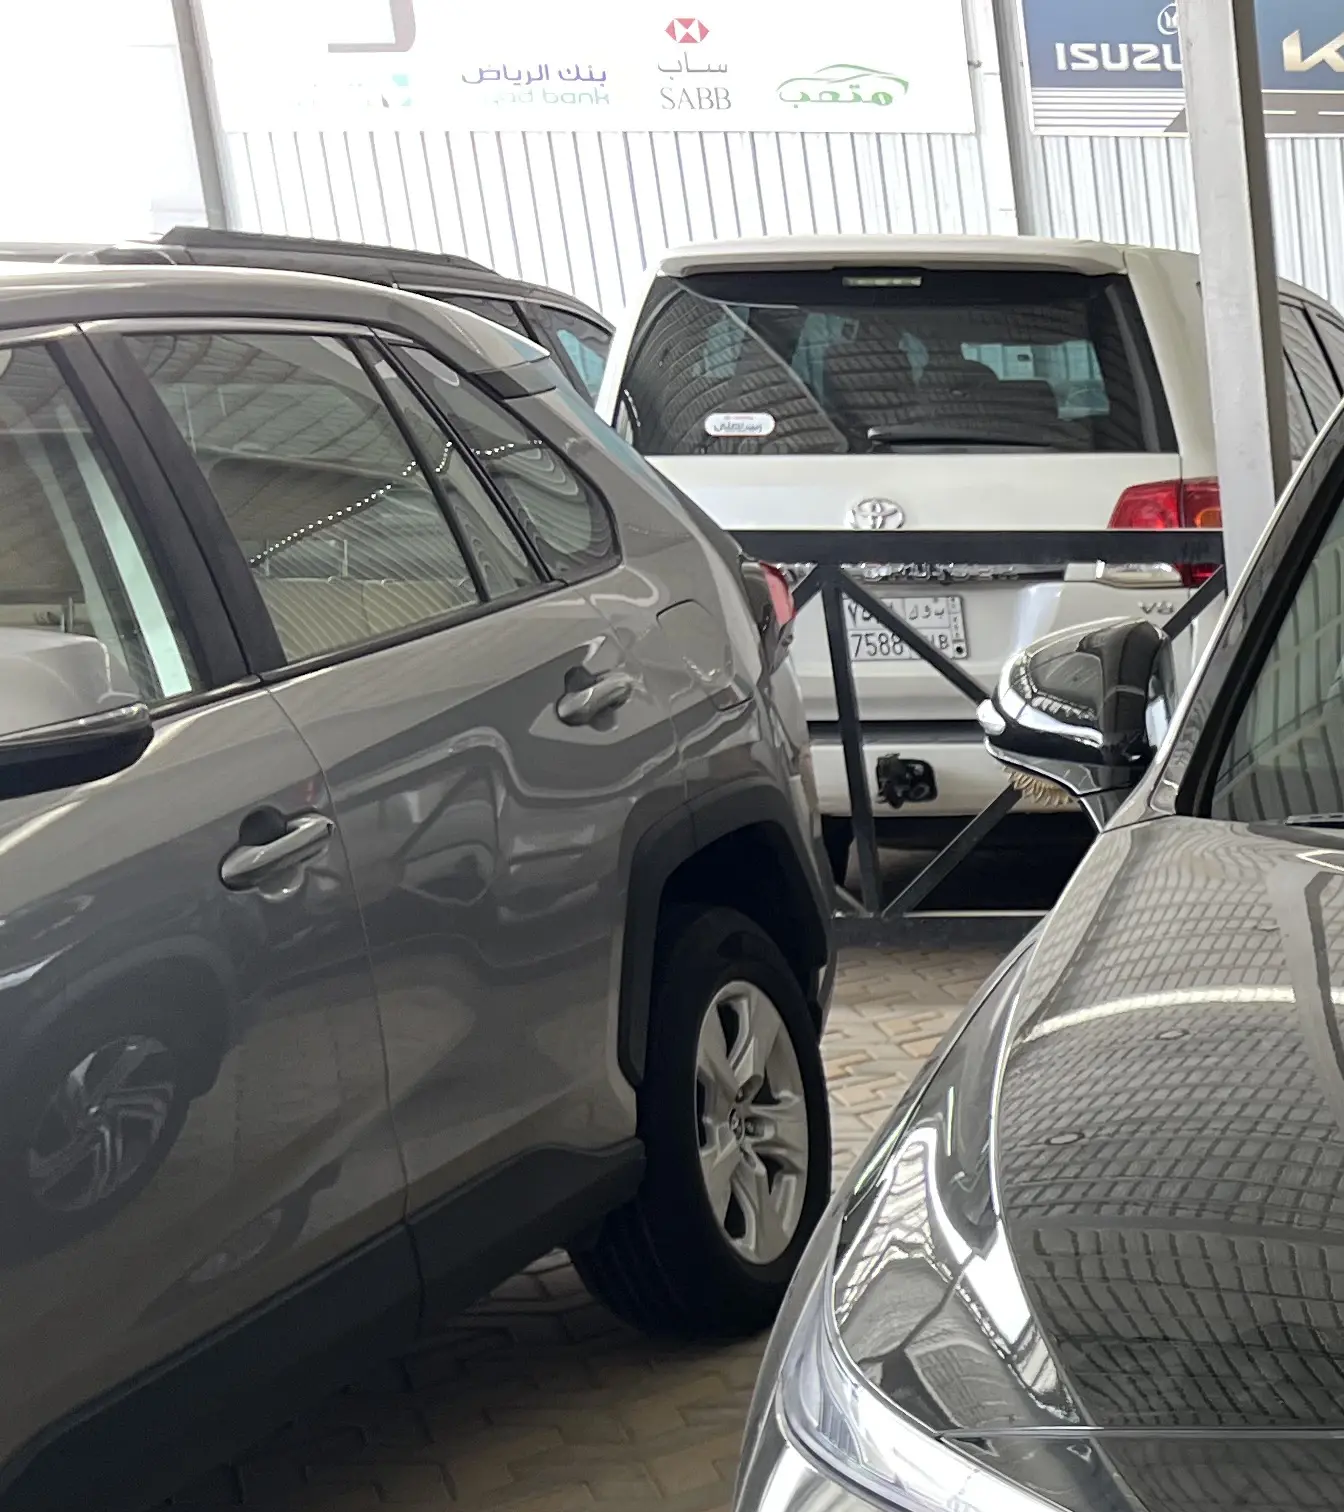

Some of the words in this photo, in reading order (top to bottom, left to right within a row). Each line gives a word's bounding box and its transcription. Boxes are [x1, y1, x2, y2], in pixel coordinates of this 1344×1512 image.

[461, 63, 550, 86] الرياض
[558, 64, 607, 87] بنك
[657, 51, 728, 80] ساب
[542, 87, 610, 105] bank
[660, 86, 732, 110] SABB
[850, 632, 904, 658] 7588
